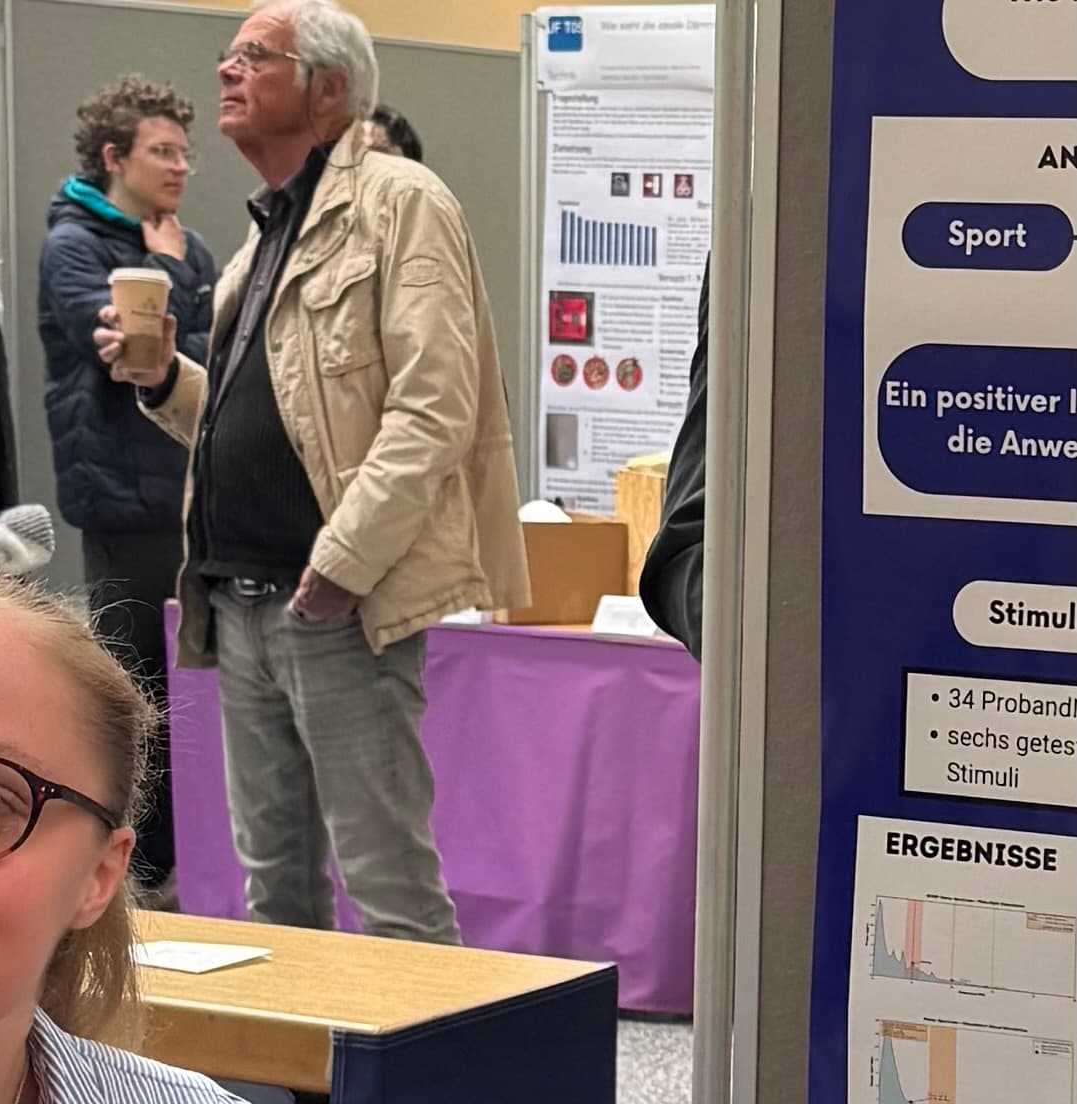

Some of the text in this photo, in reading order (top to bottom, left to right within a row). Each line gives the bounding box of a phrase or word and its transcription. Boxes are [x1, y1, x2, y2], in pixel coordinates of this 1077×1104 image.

[948, 220, 1027, 255] Sport
[886, 381, 927, 407] Ein
[937, 385, 1061, 418] positiver
[947, 424, 1077, 459] die Anwe
[989, 600, 1075, 629] Stimul
[948, 688, 975, 709] 34
[947, 728, 1010, 751] sechs
[946, 762, 1019, 789] Stimuli
[886, 832, 1057, 871] ERGEBNISSE
